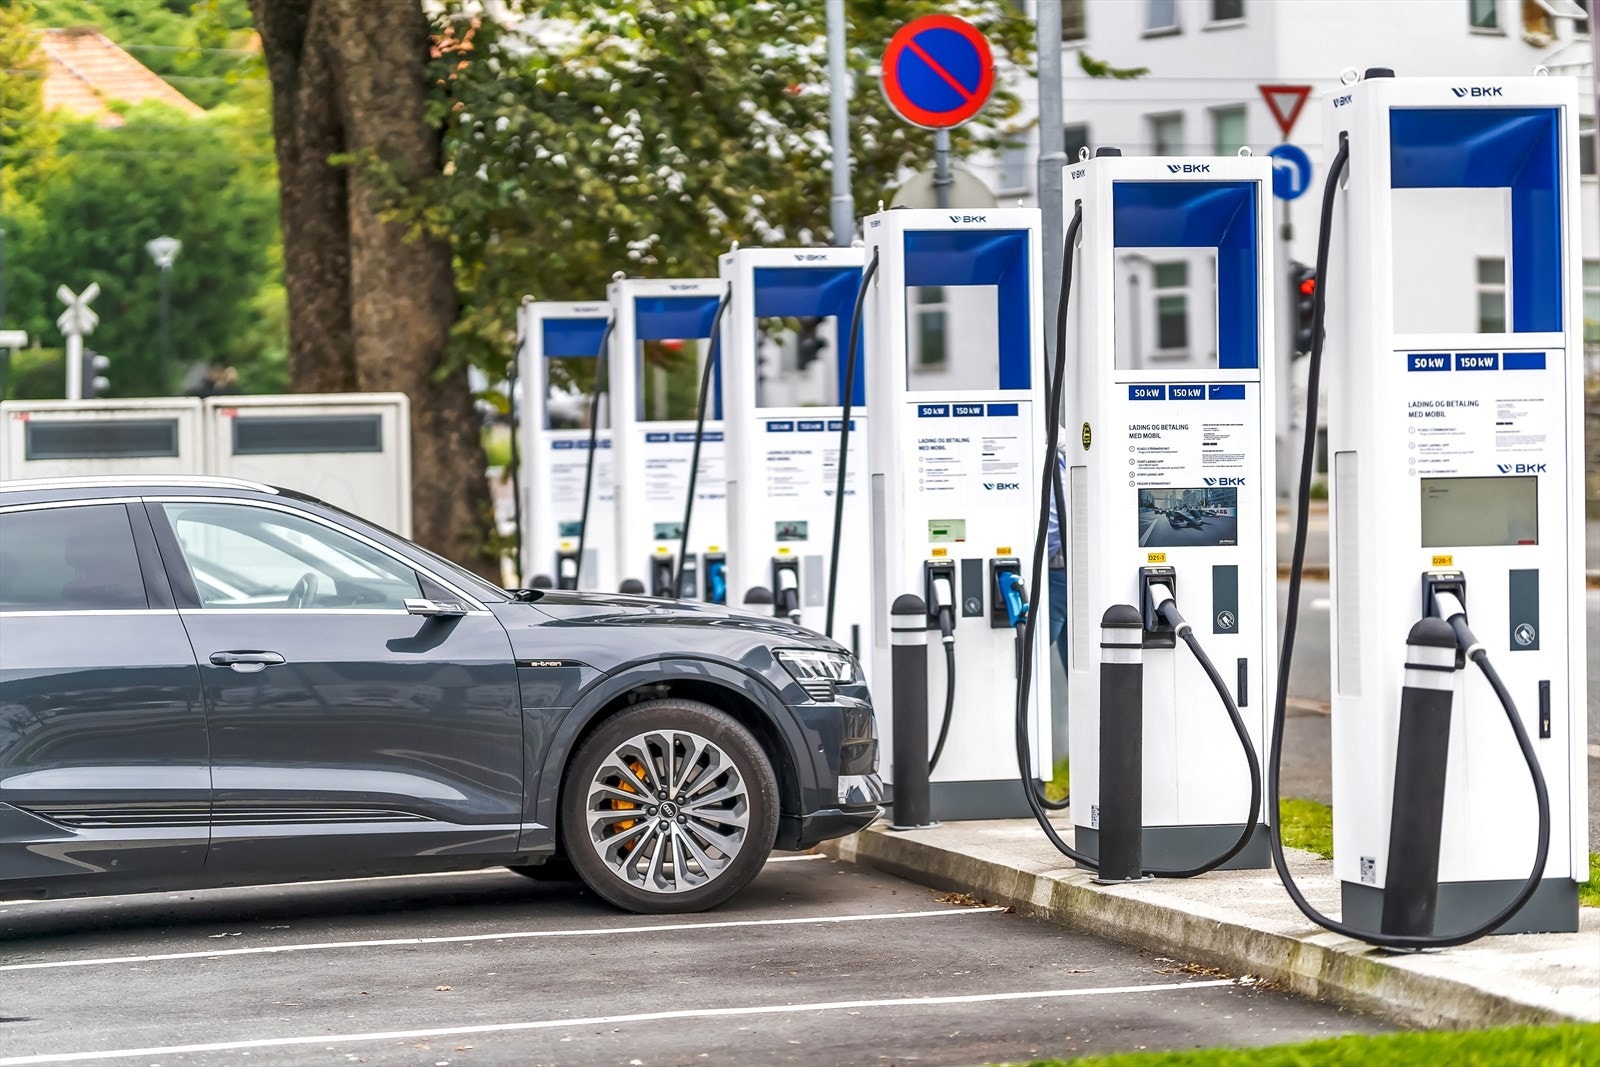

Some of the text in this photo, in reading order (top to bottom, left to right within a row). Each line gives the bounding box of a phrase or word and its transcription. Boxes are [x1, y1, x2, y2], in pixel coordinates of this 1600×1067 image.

[1471, 86, 1503, 98] BKK
[1339, 94, 1353, 106] BKK
[1183, 164, 1210, 173] BKK
[963, 215, 987, 223] BKK
[1414, 357, 1445, 369] 50 kW
[1460, 356, 1494, 368] 150 kW
[1134, 389, 1160, 397] 50 kW
[1173, 389, 1202, 397] 150 kW
[1435, 400, 1446, 408] OG
[1446, 400, 1480, 408] BETALING
[922, 407, 945, 415] 50 kW
[956, 407, 968, 415] 150
[1424, 410, 1447, 418] MOBIL
[1515, 464, 1547, 474] BKK
[1219, 477, 1246, 486] BKK
